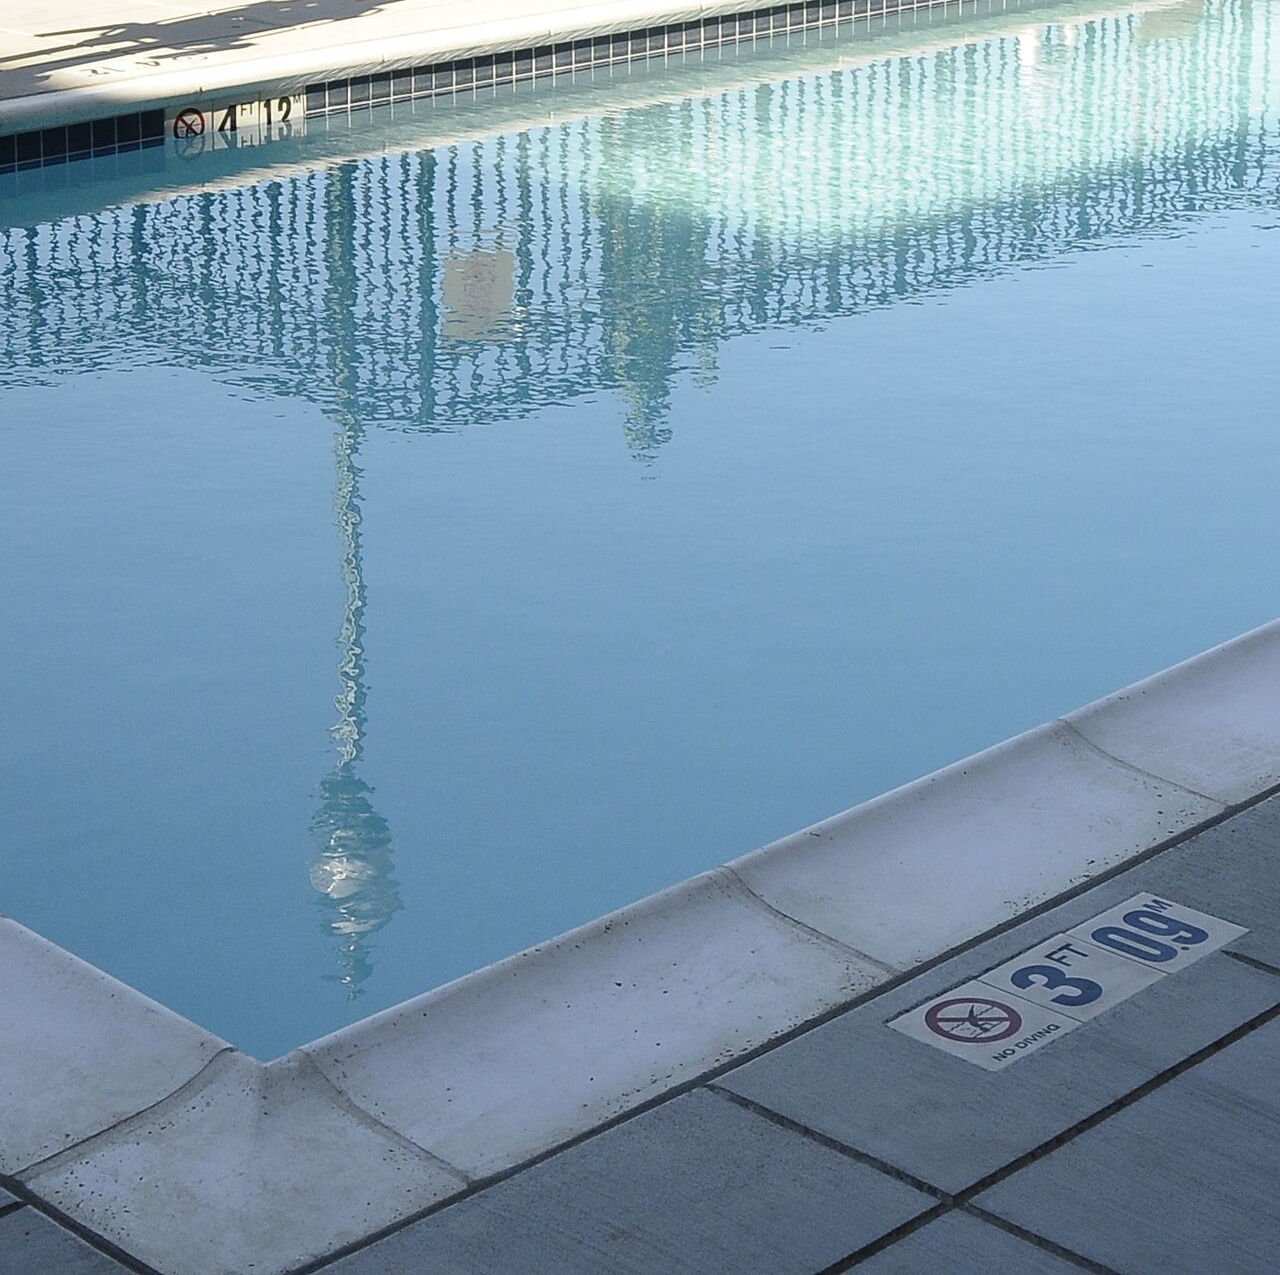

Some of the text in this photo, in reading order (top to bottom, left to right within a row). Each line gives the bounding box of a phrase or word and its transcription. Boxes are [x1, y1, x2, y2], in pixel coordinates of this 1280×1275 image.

[240, 101, 254, 116] FT
[292, 94, 302, 104] M
[1143, 898, 1172, 913] M
[1044, 942, 1088, 966] FT
[1010, 964, 1104, 1007] 3
[992, 1022, 1061, 1062] NO DIVING
